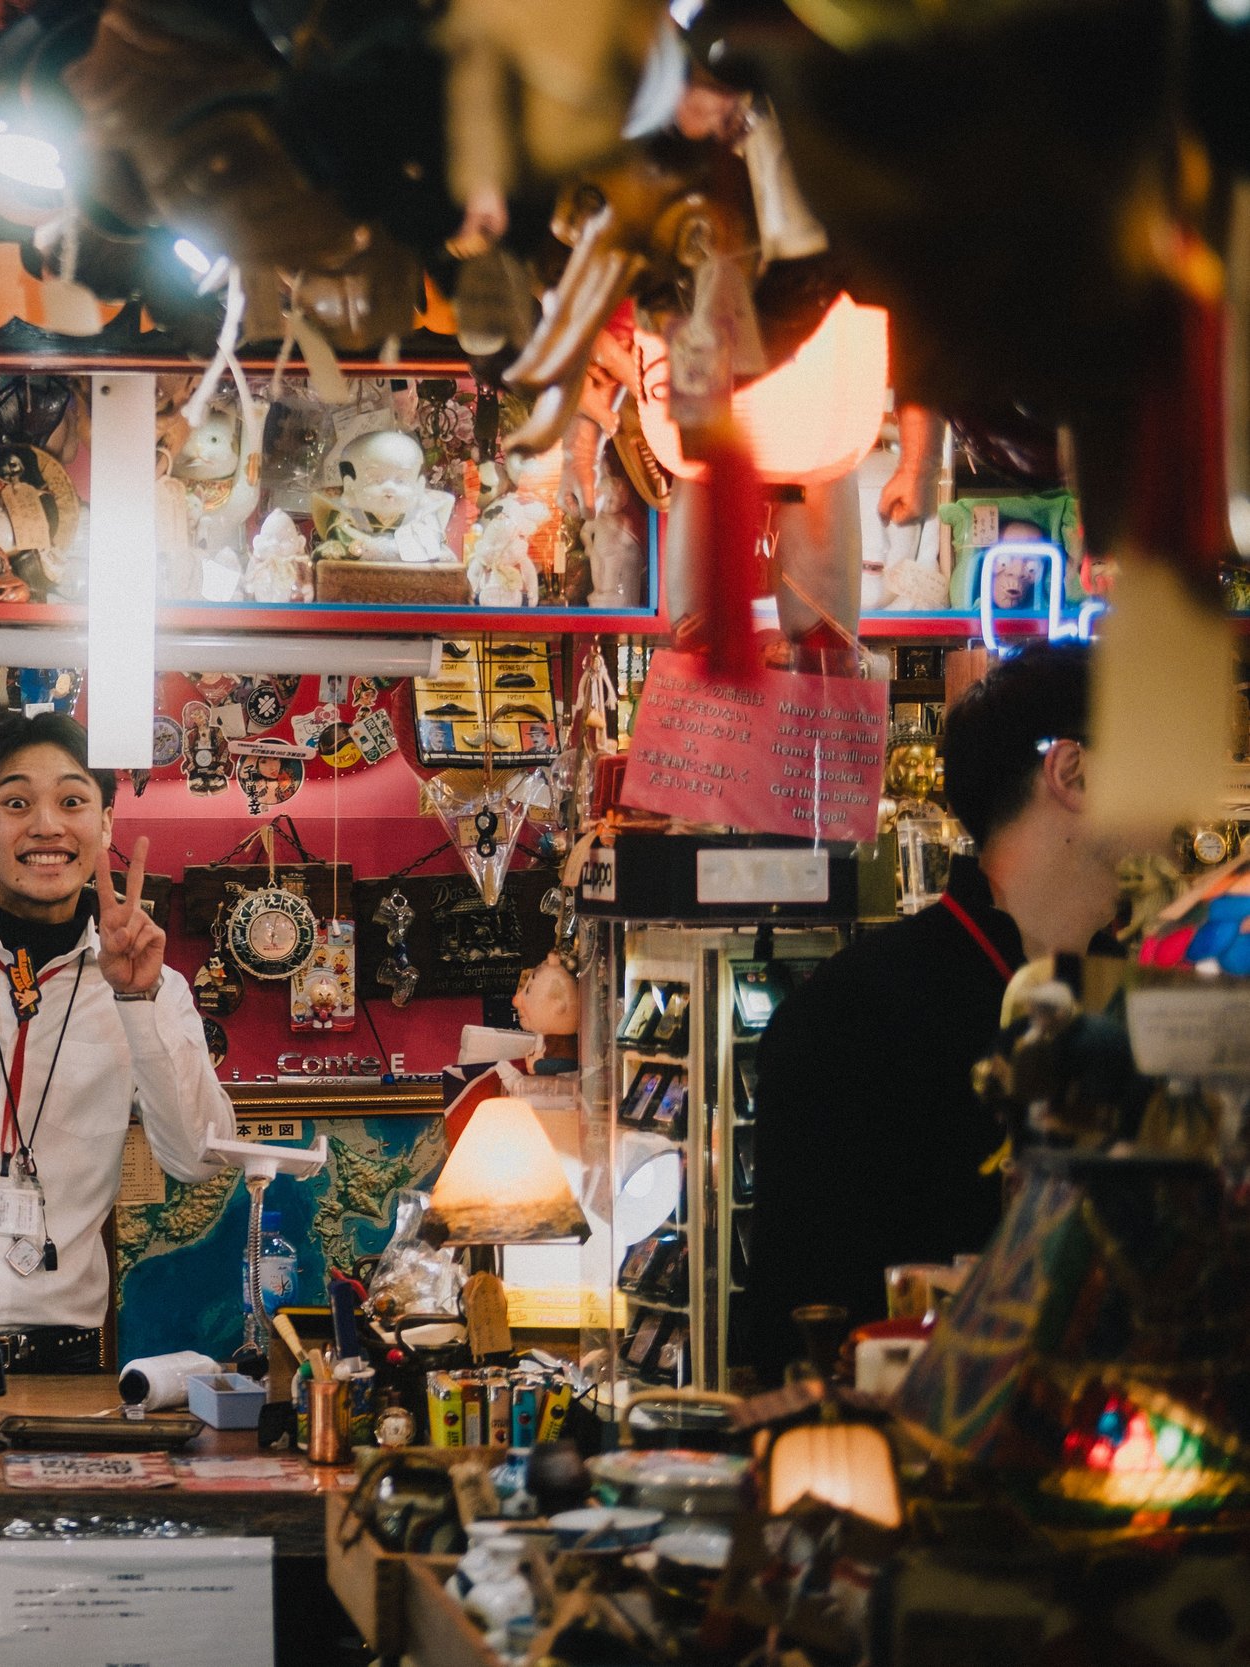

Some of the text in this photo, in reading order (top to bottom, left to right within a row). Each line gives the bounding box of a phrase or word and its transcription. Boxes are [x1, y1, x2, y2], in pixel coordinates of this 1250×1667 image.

[498, 664, 530, 672] WEDNESDAY
[778, 701, 883, 726] Many of our items
[778, 725, 879, 745] are one-of-a-kind
[771, 742, 810, 758] items
[838, 750, 859, 762] will
[860, 754, 880, 766] not
[783, 764, 865, 785] be retocked.
[770, 784, 797, 798] Get
[833, 790, 870, 805] before
[823, 811, 848, 825] go!!
[276, 1052, 406, 1076] Conte E
[306, 1077, 351, 1086] MOVE
